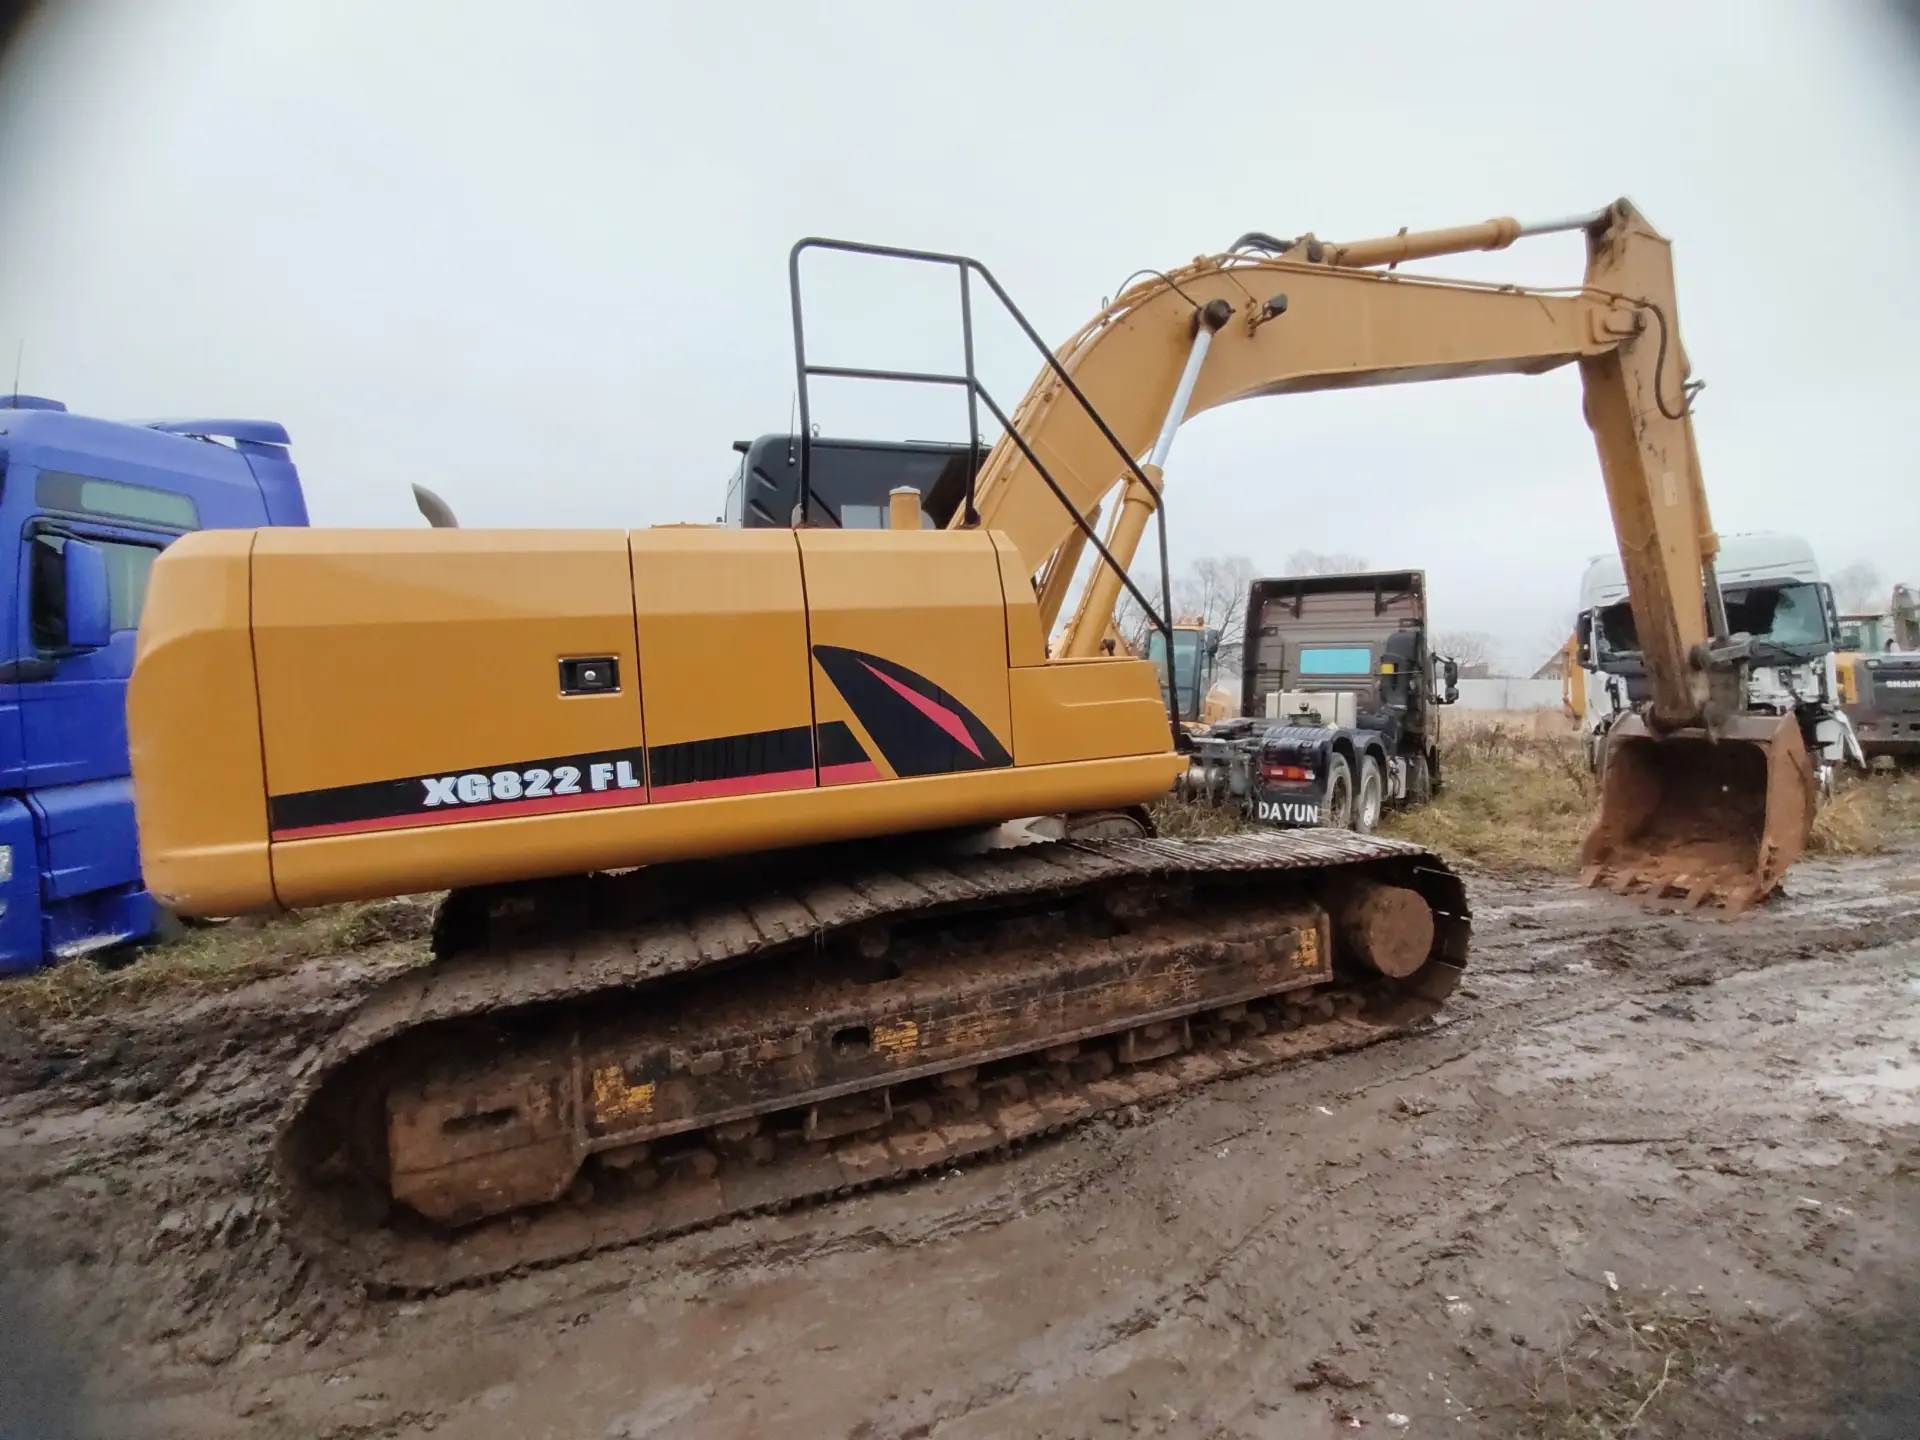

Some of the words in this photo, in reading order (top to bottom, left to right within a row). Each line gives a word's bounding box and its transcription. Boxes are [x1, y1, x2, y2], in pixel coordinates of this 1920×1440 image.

[421, 766, 582, 807] XG822
[589, 761, 640, 791] FL
[1258, 801, 1318, 823] DAYUN
